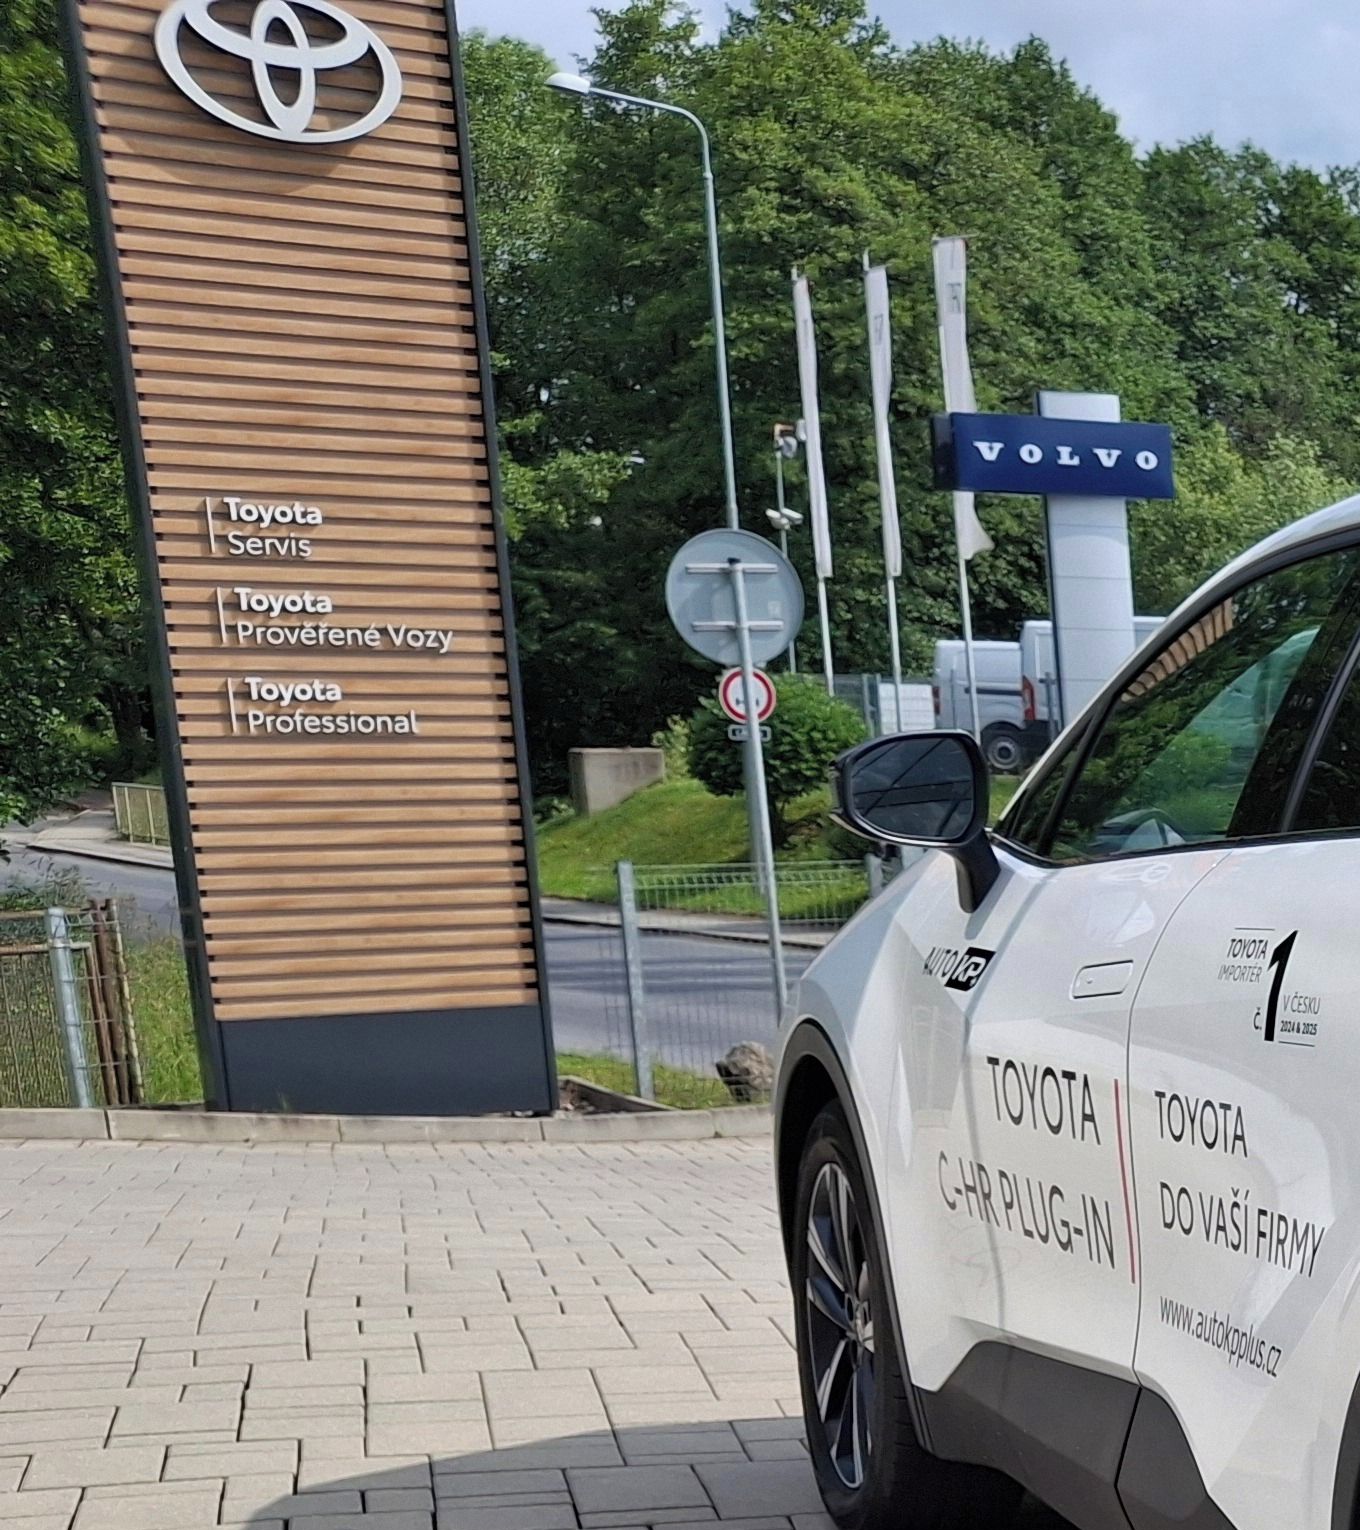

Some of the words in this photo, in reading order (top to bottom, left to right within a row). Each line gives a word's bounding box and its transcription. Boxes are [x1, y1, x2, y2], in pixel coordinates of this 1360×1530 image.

[972, 440, 1159, 471] VOLVO
[223, 497, 323, 528] Toyota
[227, 531, 313, 557] Servis
[233, 587, 333, 618] Toyota
[236, 621, 382, 647] Prověřené
[387, 624, 453, 653] Vozy
[244, 677, 343, 707] Toyota
[247, 709, 420, 735] Professional
[922, 947, 959, 978] AUTO
[1227, 938, 1269, 960] TOYOTA
[1218, 962, 1263, 983] IMPORTÉR
[1264, 929, 1298, 1042] 1
[1283, 994, 1291, 1012] V
[1291, 991, 1321, 1015] ČESKU
[1280, 1020, 1295, 1033] 2024
[1295, 1021, 1301, 1034] &
[1301, 1022, 1318, 1036] 2025
[986, 1055, 1101, 1146] TOYOTA
[1154, 1090, 1248, 1158] TOYOTA
[938, 1150, 1000, 1228] C-HR
[998, 1169, 1115, 1270] PLUG-IN
[1160, 1181, 1194, 1236] DO
[1199, 1186, 1250, 1255] VAŠÍ
[1256, 1207, 1325, 1278] FIRMY
[1160, 1295, 1282, 1378] www.autokpplus.cz
